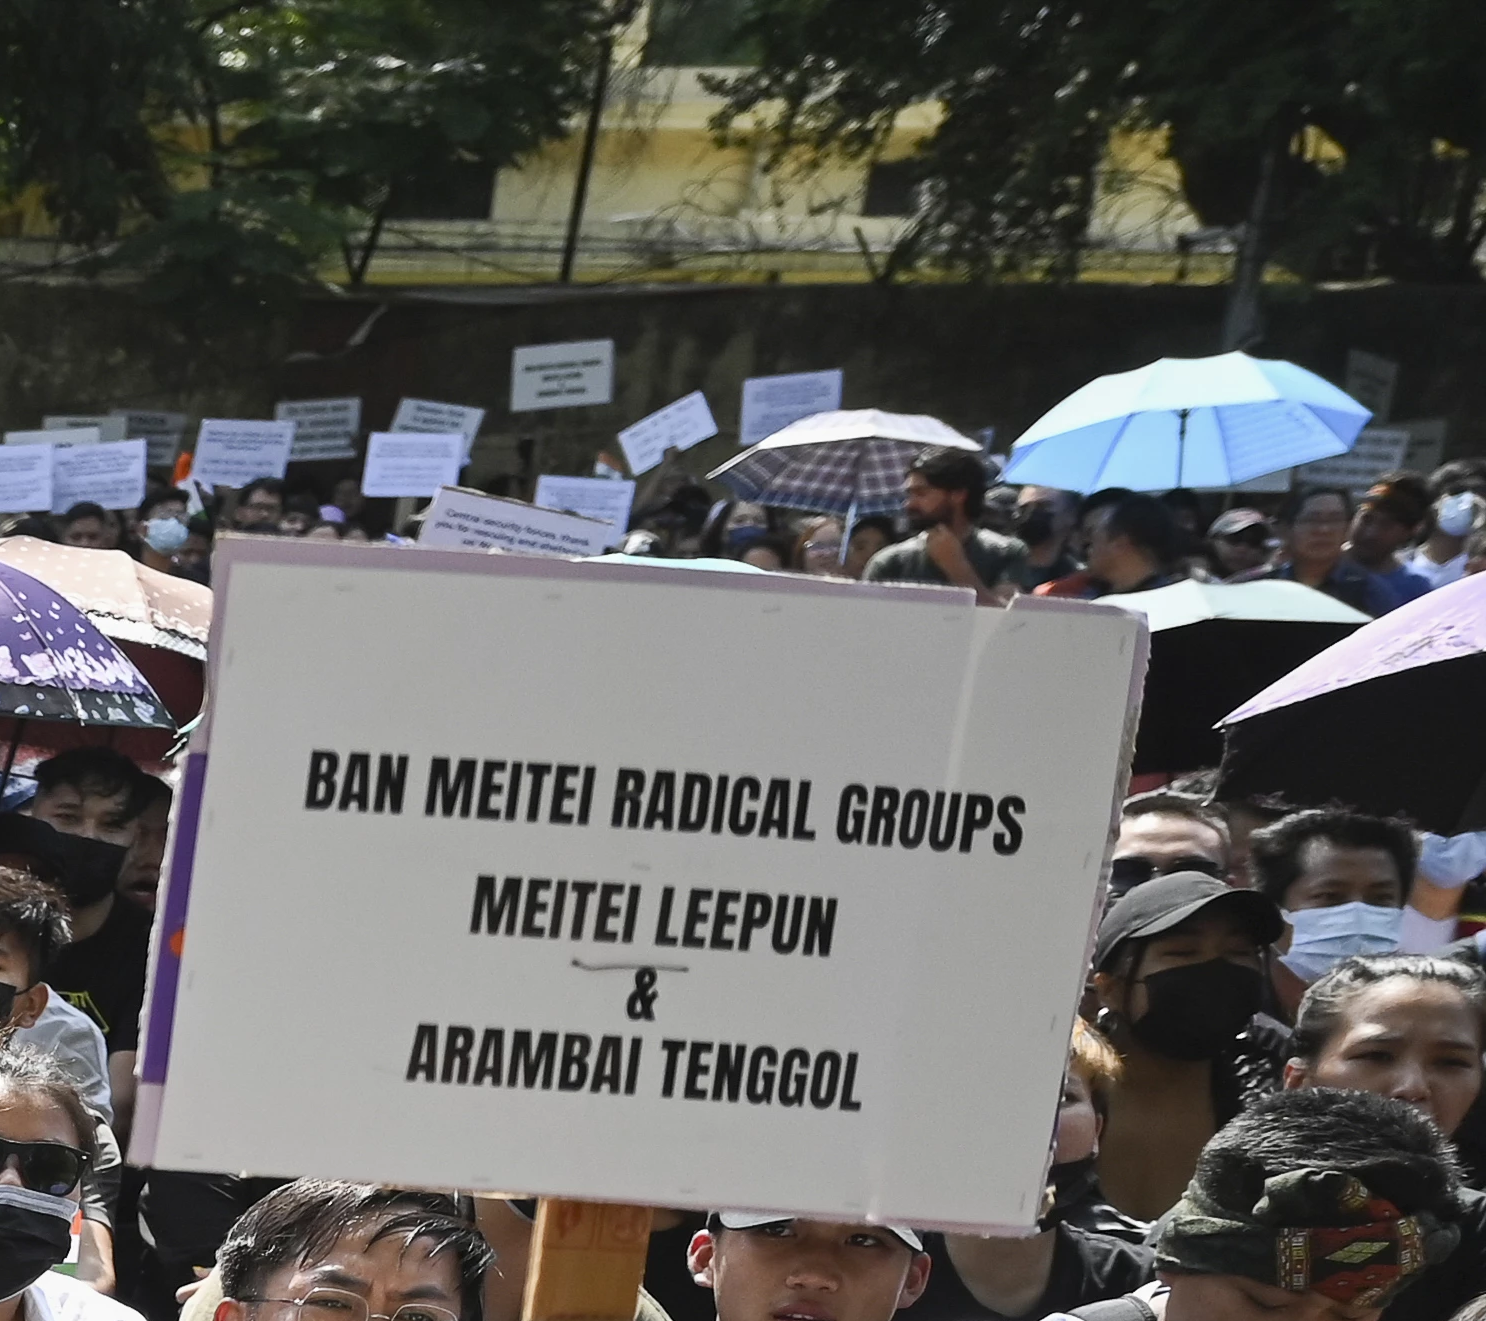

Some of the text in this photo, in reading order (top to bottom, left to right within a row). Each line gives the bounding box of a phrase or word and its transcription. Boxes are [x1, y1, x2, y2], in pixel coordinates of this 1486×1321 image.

[304, 749, 1026, 856] BAN MEITEI RADICAL GROUPS
[469, 874, 839, 958] MEITEI LEEPUN
[626, 965, 659, 1022] &
[405, 1023, 862, 1112] ARAMBAI TENGGOL
